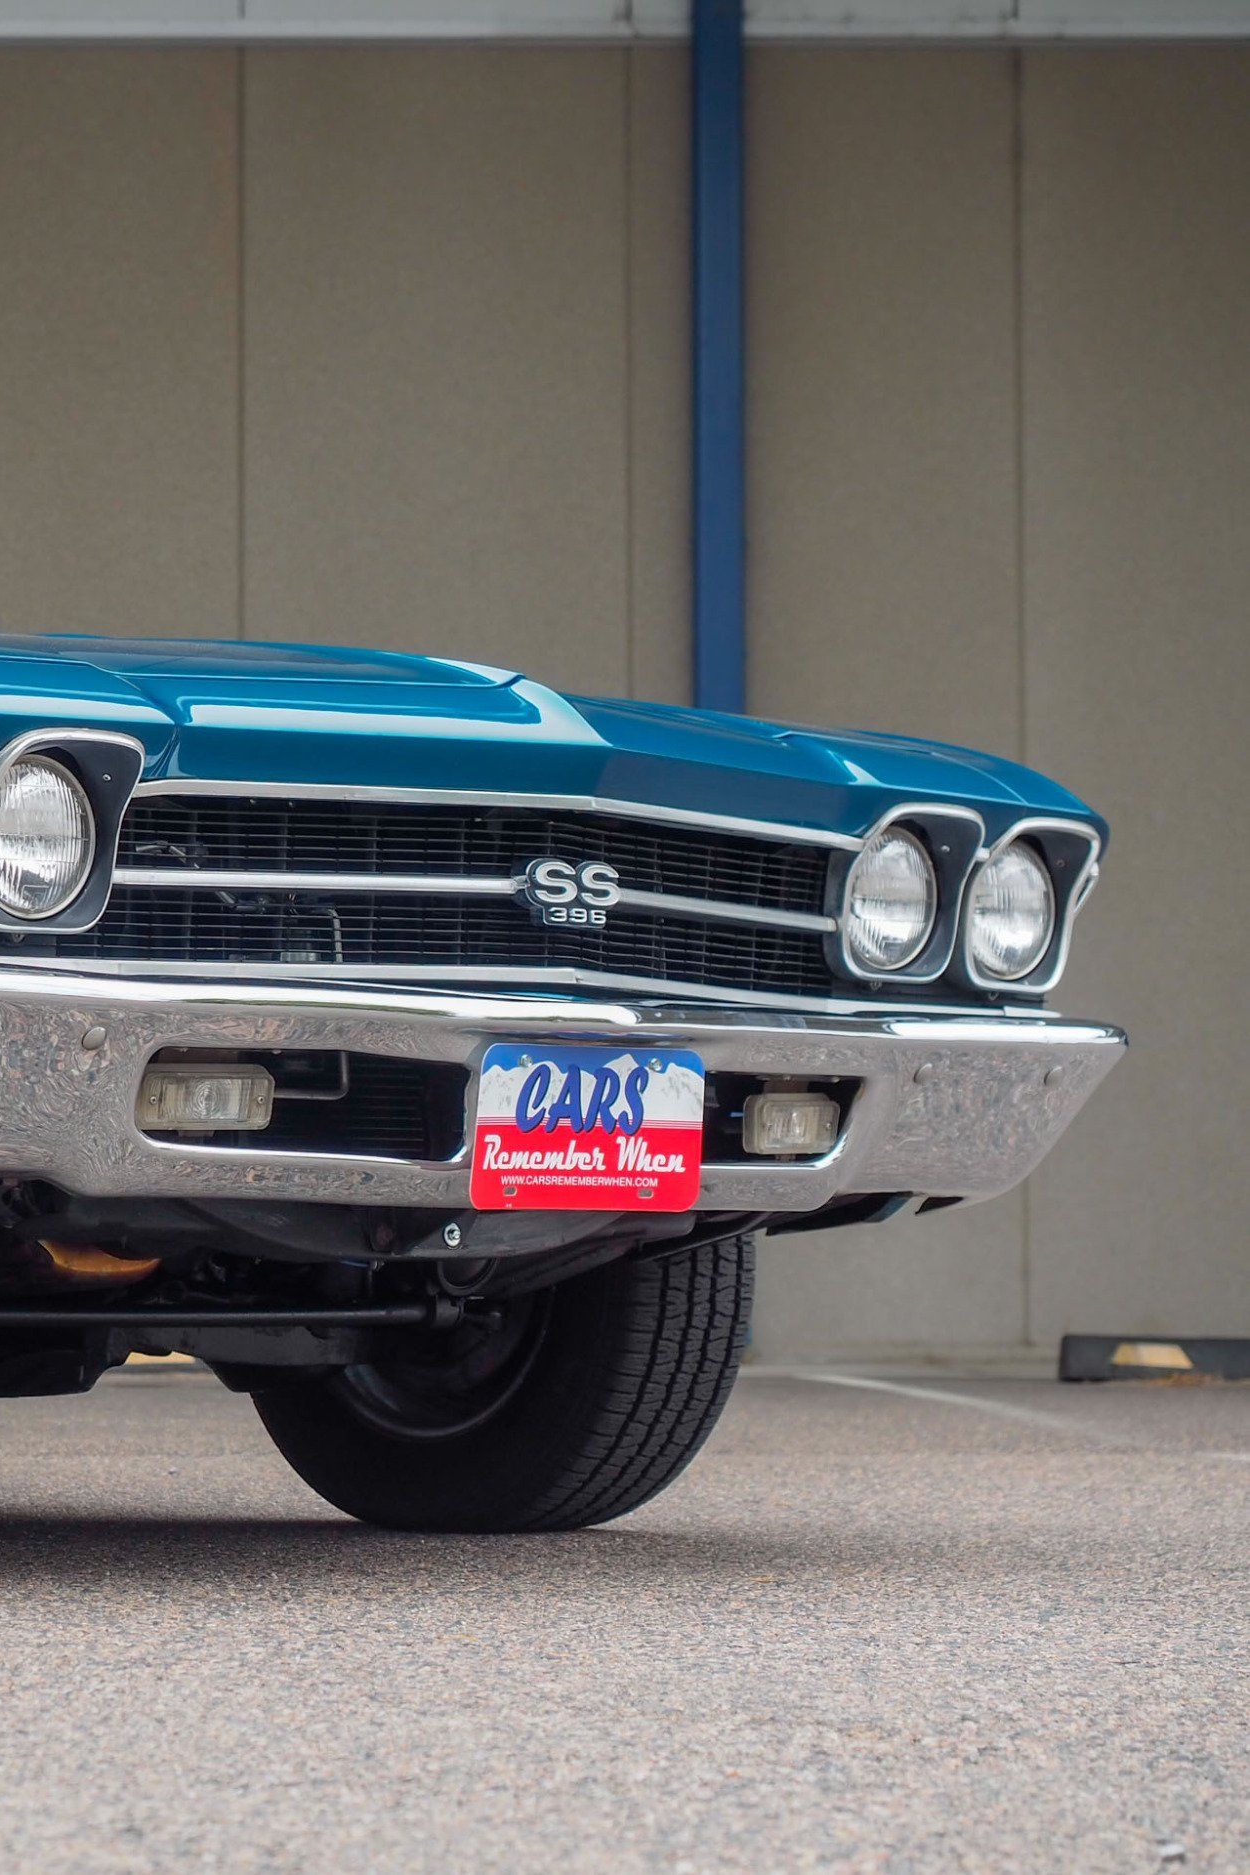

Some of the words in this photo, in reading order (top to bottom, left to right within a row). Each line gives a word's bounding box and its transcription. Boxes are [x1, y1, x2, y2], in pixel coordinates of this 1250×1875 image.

[535, 861, 620, 906] SS
[549, 906, 607, 924] 396
[515, 1064, 649, 1135] CARS
[482, 1134, 606, 1171] Remember
[616, 1136, 686, 1173] When
[500, 1175, 659, 1188] WWW.CARSREMEMBERWHEN.COM
